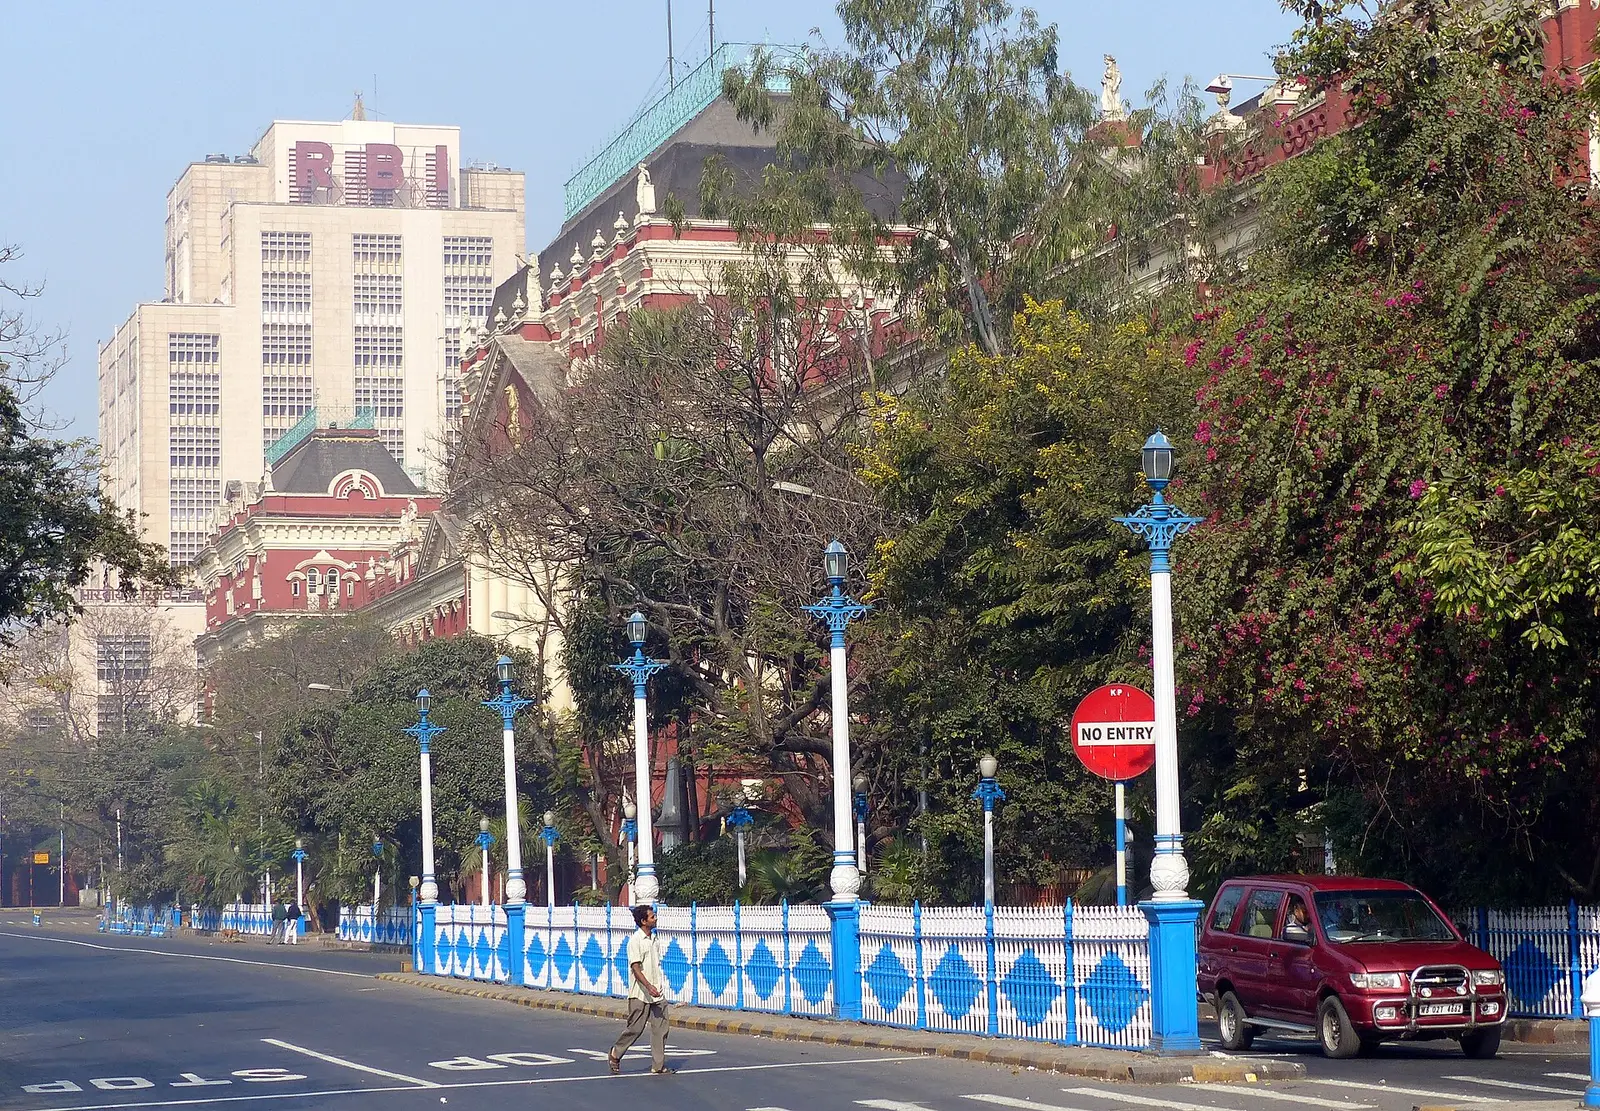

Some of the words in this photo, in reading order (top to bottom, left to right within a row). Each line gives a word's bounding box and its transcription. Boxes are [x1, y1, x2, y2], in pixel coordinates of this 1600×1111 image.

[296, 141, 448, 191] RBI
[1081, 728, 1102, 741] NO
[1107, 727, 1154, 740] ENTRY
[20, 1068, 308, 1093] STOP
